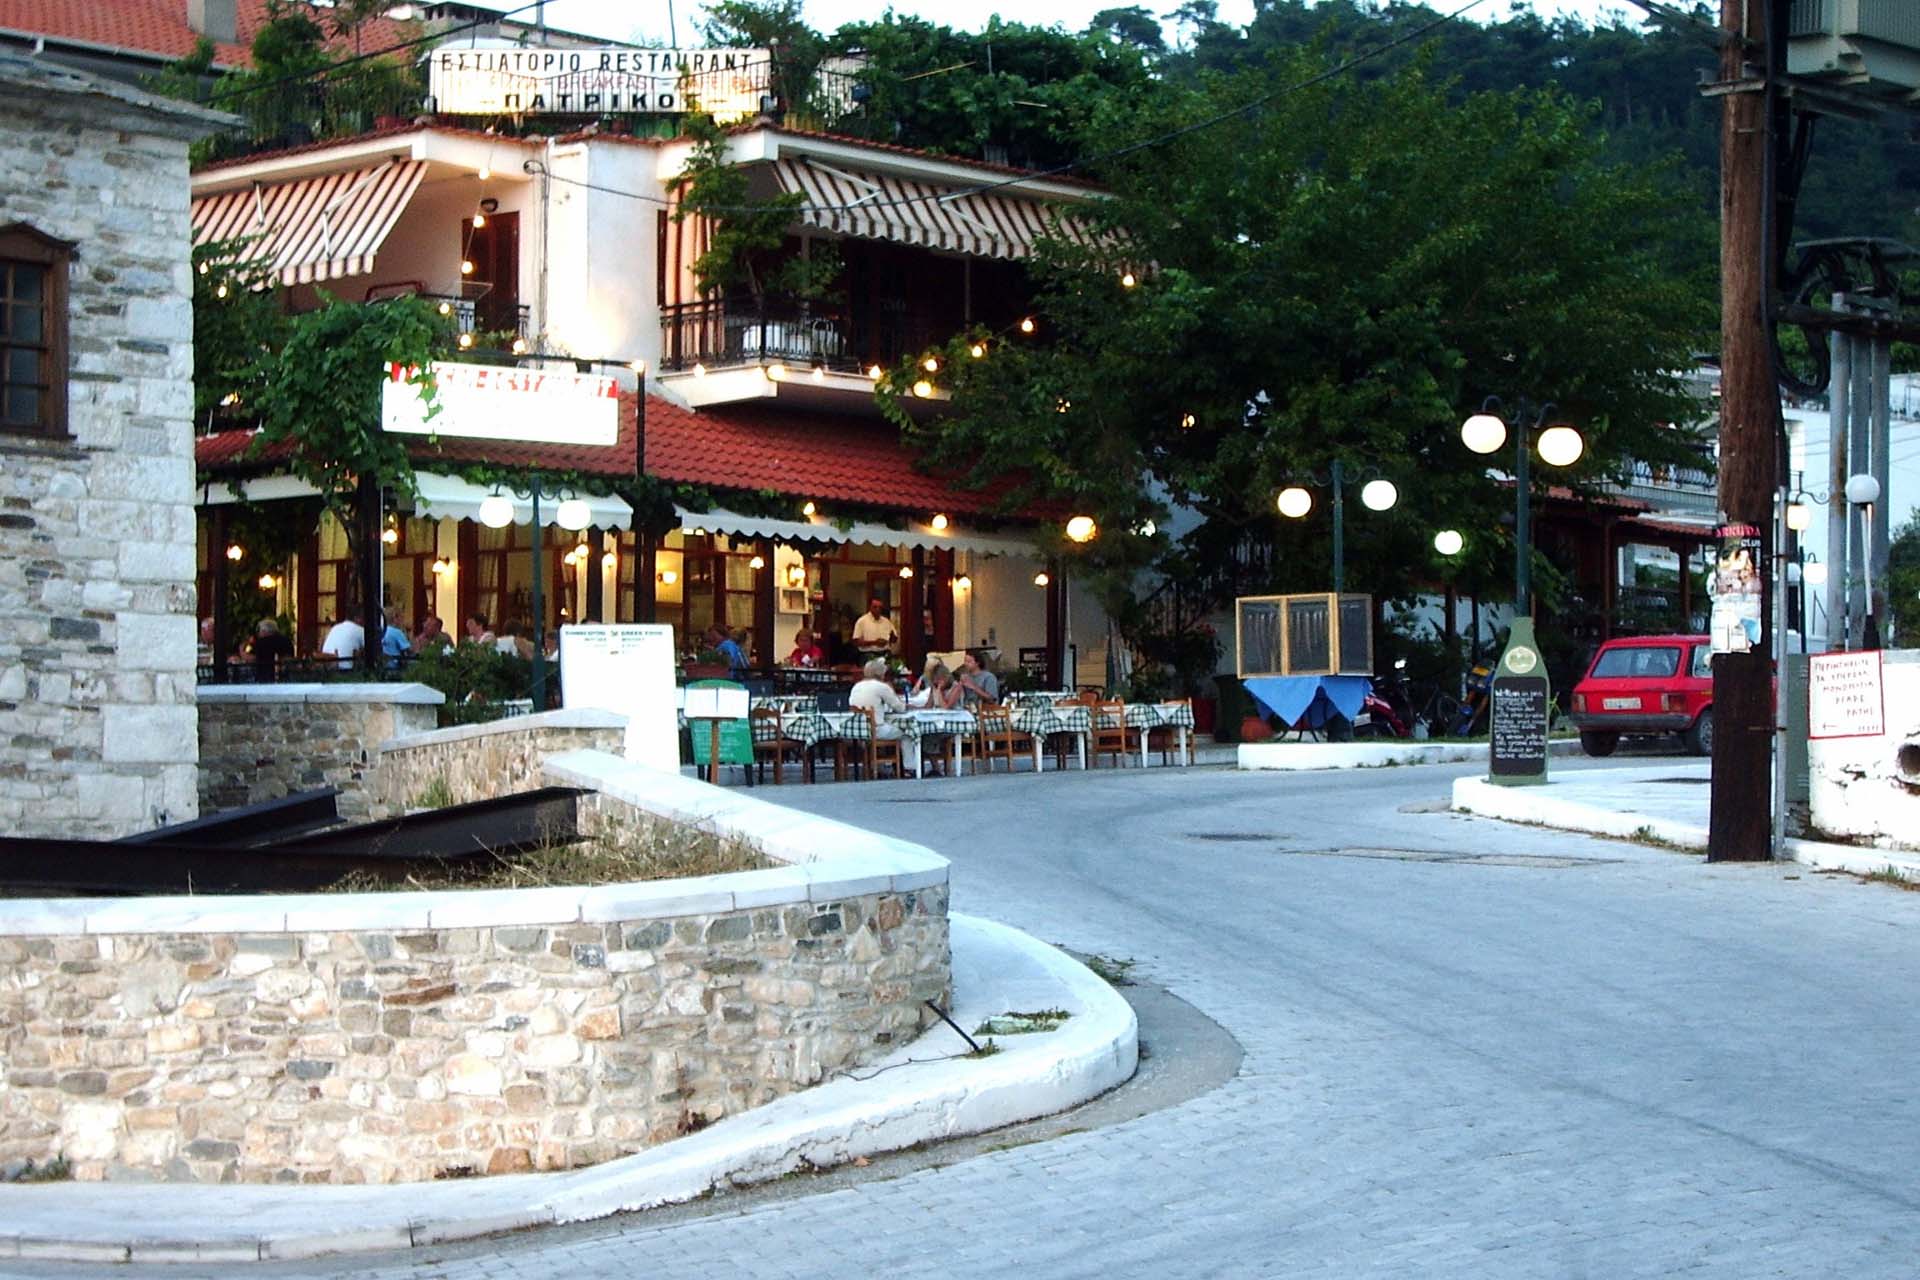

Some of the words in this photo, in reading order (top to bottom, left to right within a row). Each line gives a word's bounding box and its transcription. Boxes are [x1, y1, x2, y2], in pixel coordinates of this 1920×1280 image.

[441, 52, 581, 72] ΕΣΤΙΑΤΟΡΙΟ
[599, 52, 752, 72] RESTAURANT
[557, 75, 655, 90] BREAKFAST
